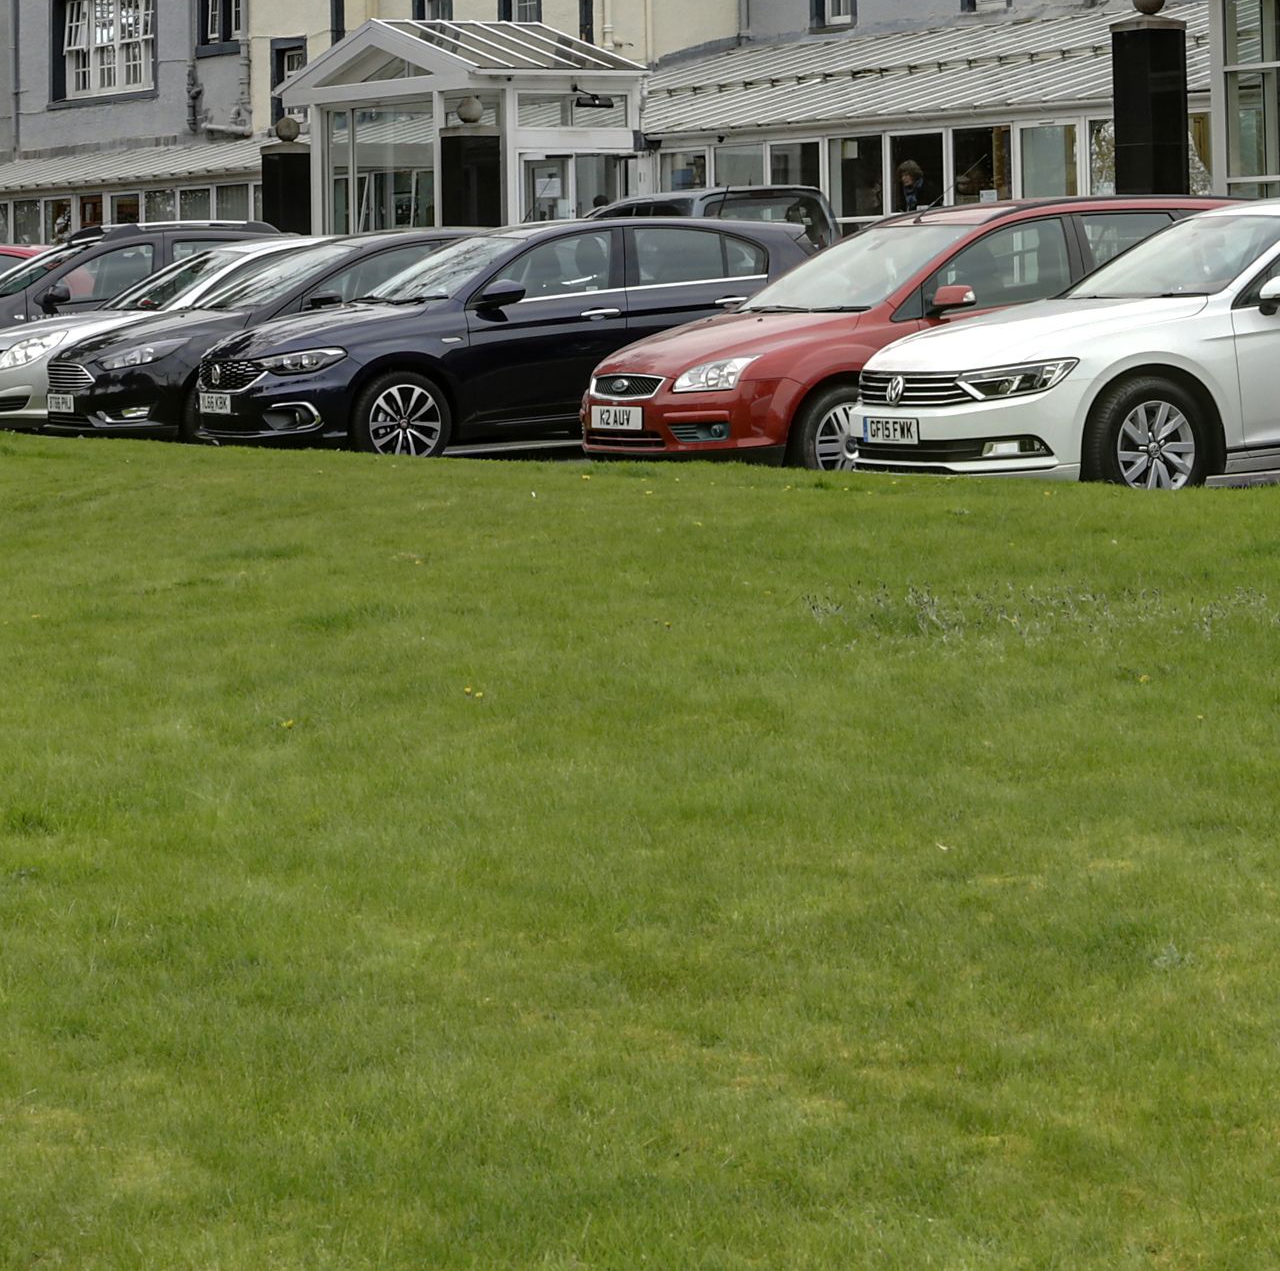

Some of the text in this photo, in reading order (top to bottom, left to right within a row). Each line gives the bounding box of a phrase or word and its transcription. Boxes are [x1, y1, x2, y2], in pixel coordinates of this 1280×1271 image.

[599, 409, 611, 426] K2
[870, 420, 914, 440] GF15 FWK
